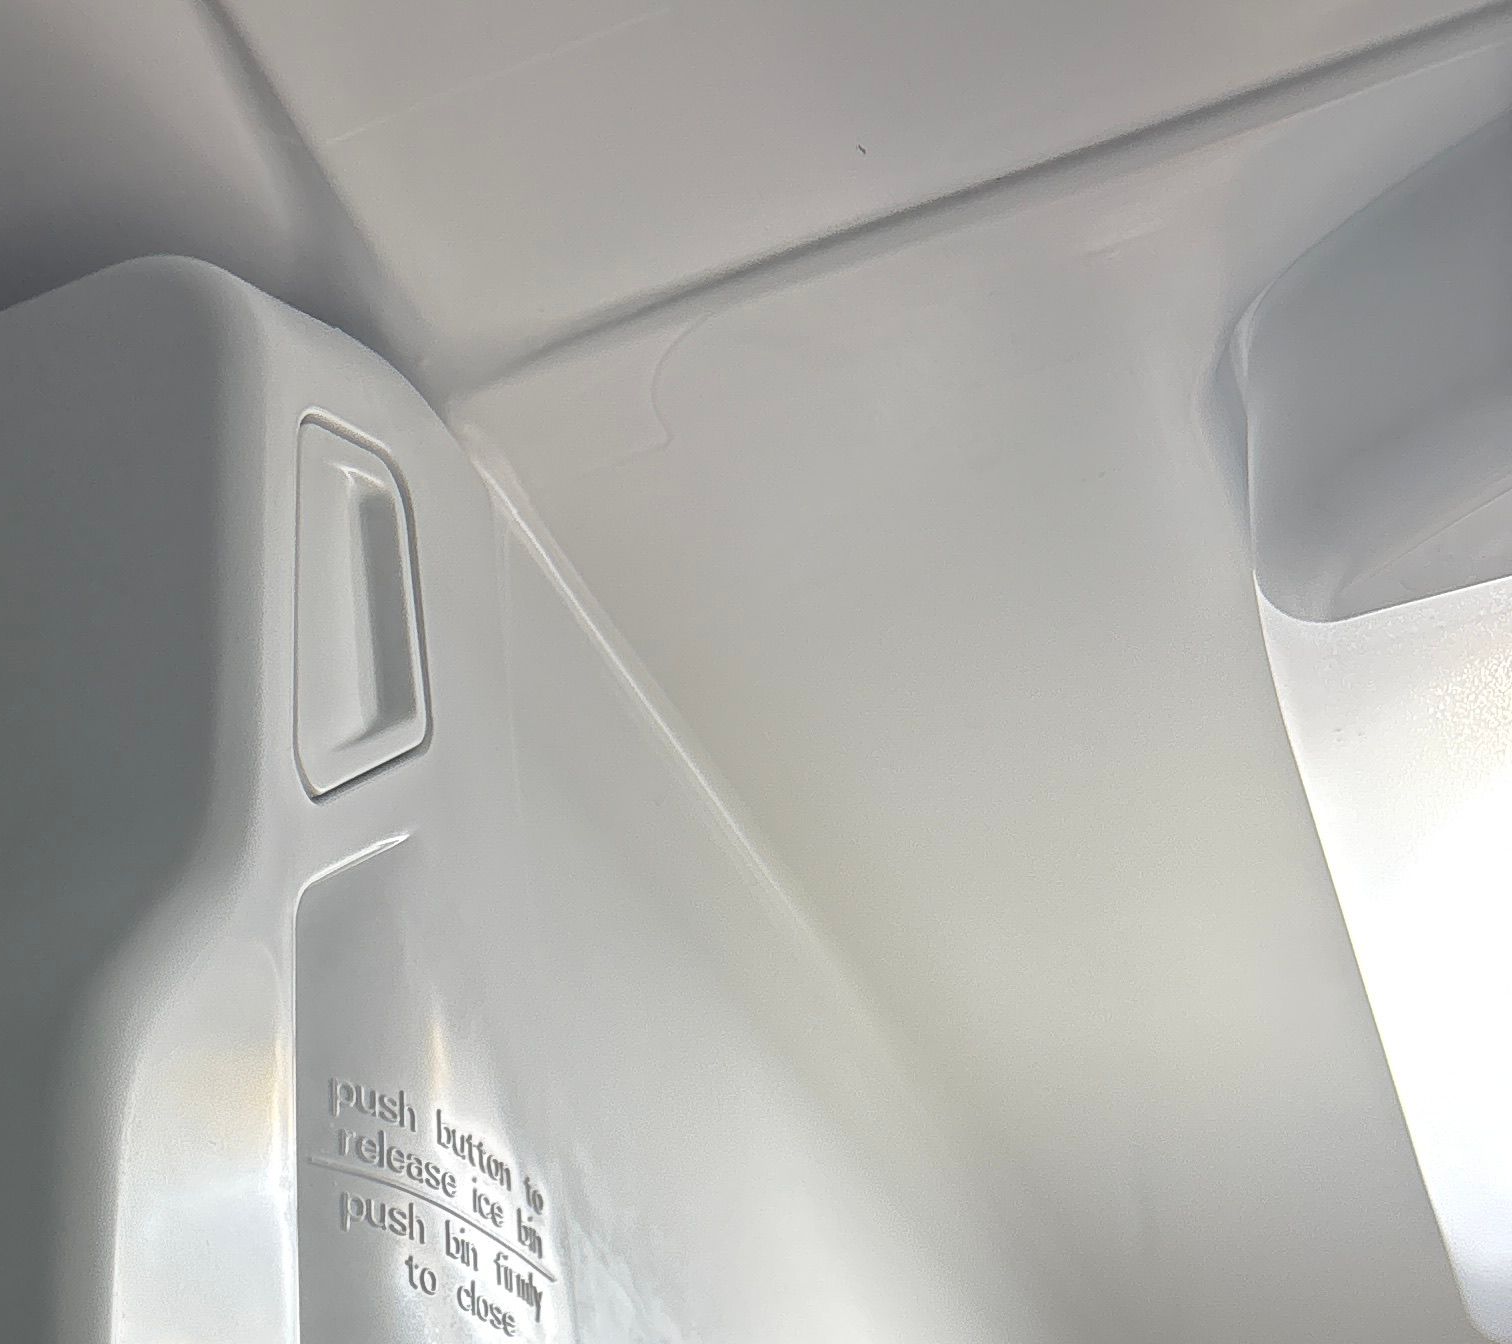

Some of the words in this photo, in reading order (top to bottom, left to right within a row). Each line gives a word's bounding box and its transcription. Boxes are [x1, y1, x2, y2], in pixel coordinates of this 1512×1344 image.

[328, 1077, 416, 1133] push
[436, 1108, 512, 1192] button
[523, 1176, 545, 1216] to
[338, 1128, 458, 1199] release
[472, 1176, 504, 1228] ice
[517, 1208, 543, 1260] bin
[340, 1190, 425, 1245] push
[444, 1219, 479, 1272] bin
[493, 1251, 544, 1324] firmly
[405, 1255, 438, 1297] to
[456, 1280, 518, 1338] close
